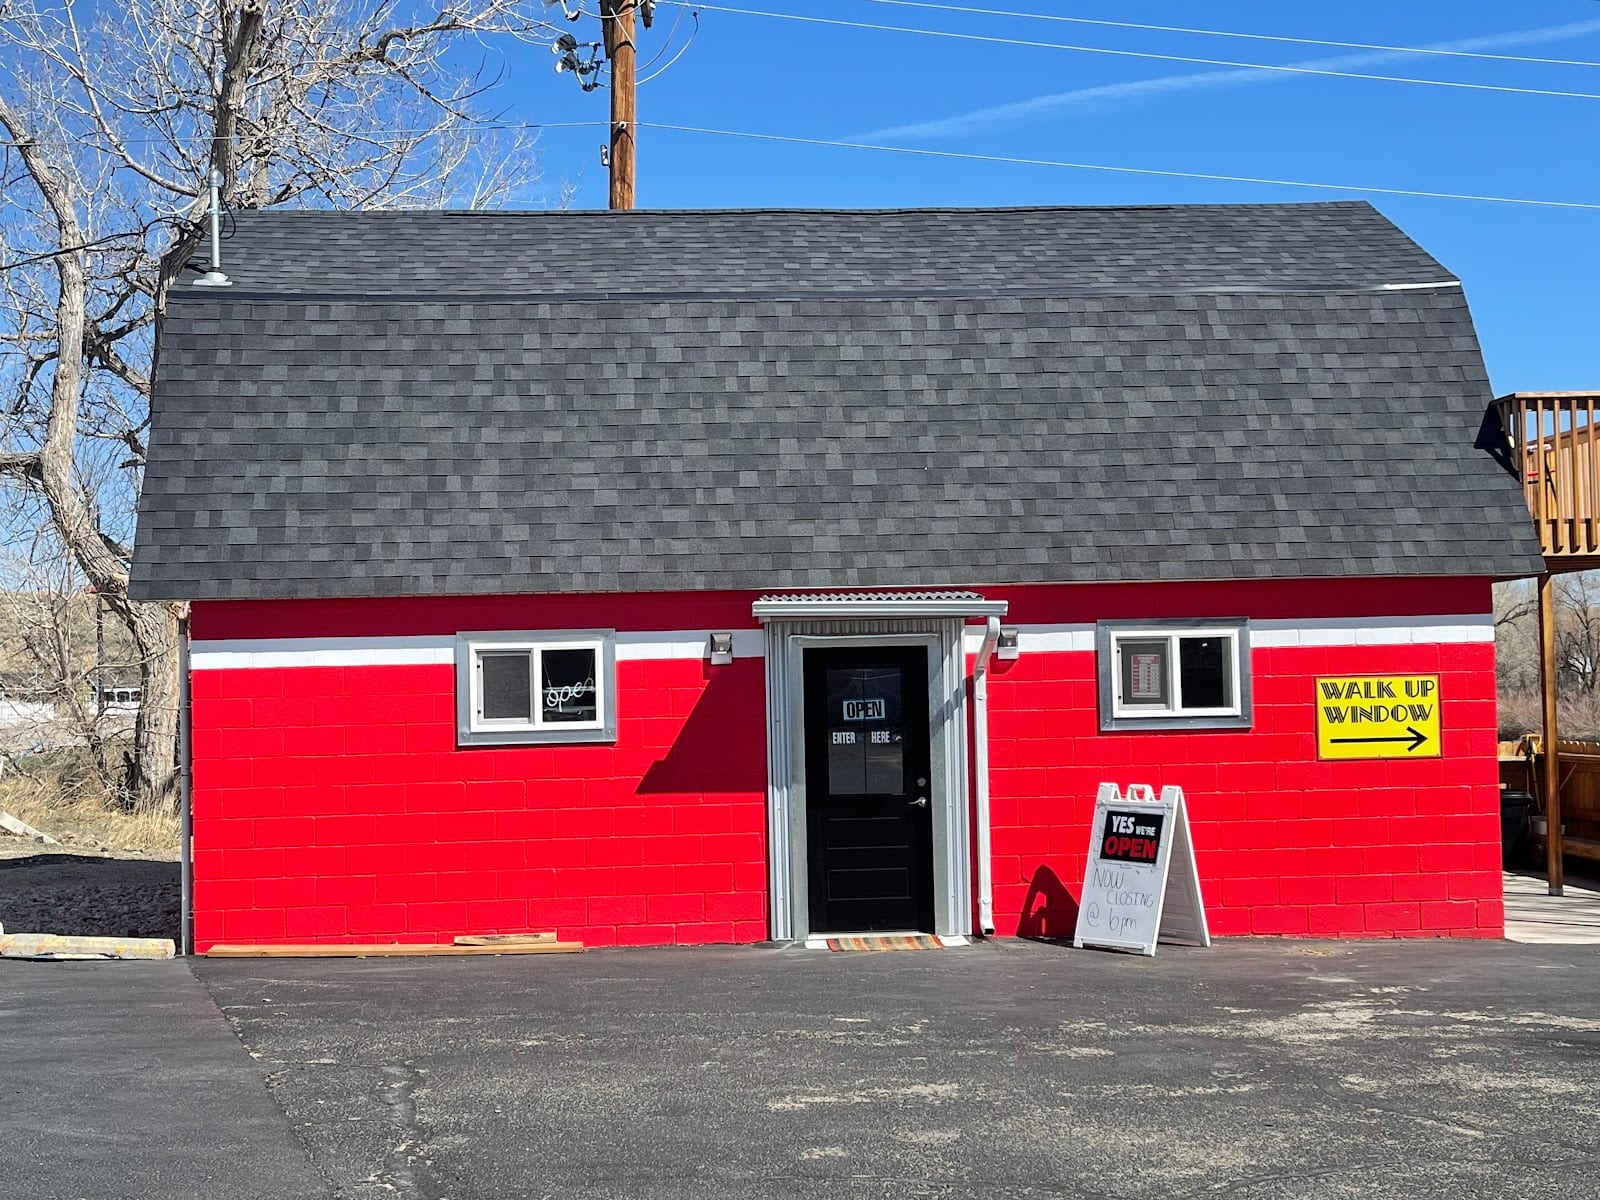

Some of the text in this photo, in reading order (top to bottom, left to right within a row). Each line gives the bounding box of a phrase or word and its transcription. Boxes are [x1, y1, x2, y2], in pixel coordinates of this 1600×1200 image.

[1320, 679, 1435, 700] WALK UP
[846, 701, 882, 719] OPEN
[1323, 703, 1433, 724] WINDOW
[832, 731, 890, 745] ENTER HERE
[1111, 815, 1157, 837] YES WE'RE
[1104, 835, 1158, 860] OPEN
[1092, 867, 1125, 889] NOW
[1106, 891, 1154, 907] CLOSING
[1086, 901, 1101, 928] @
